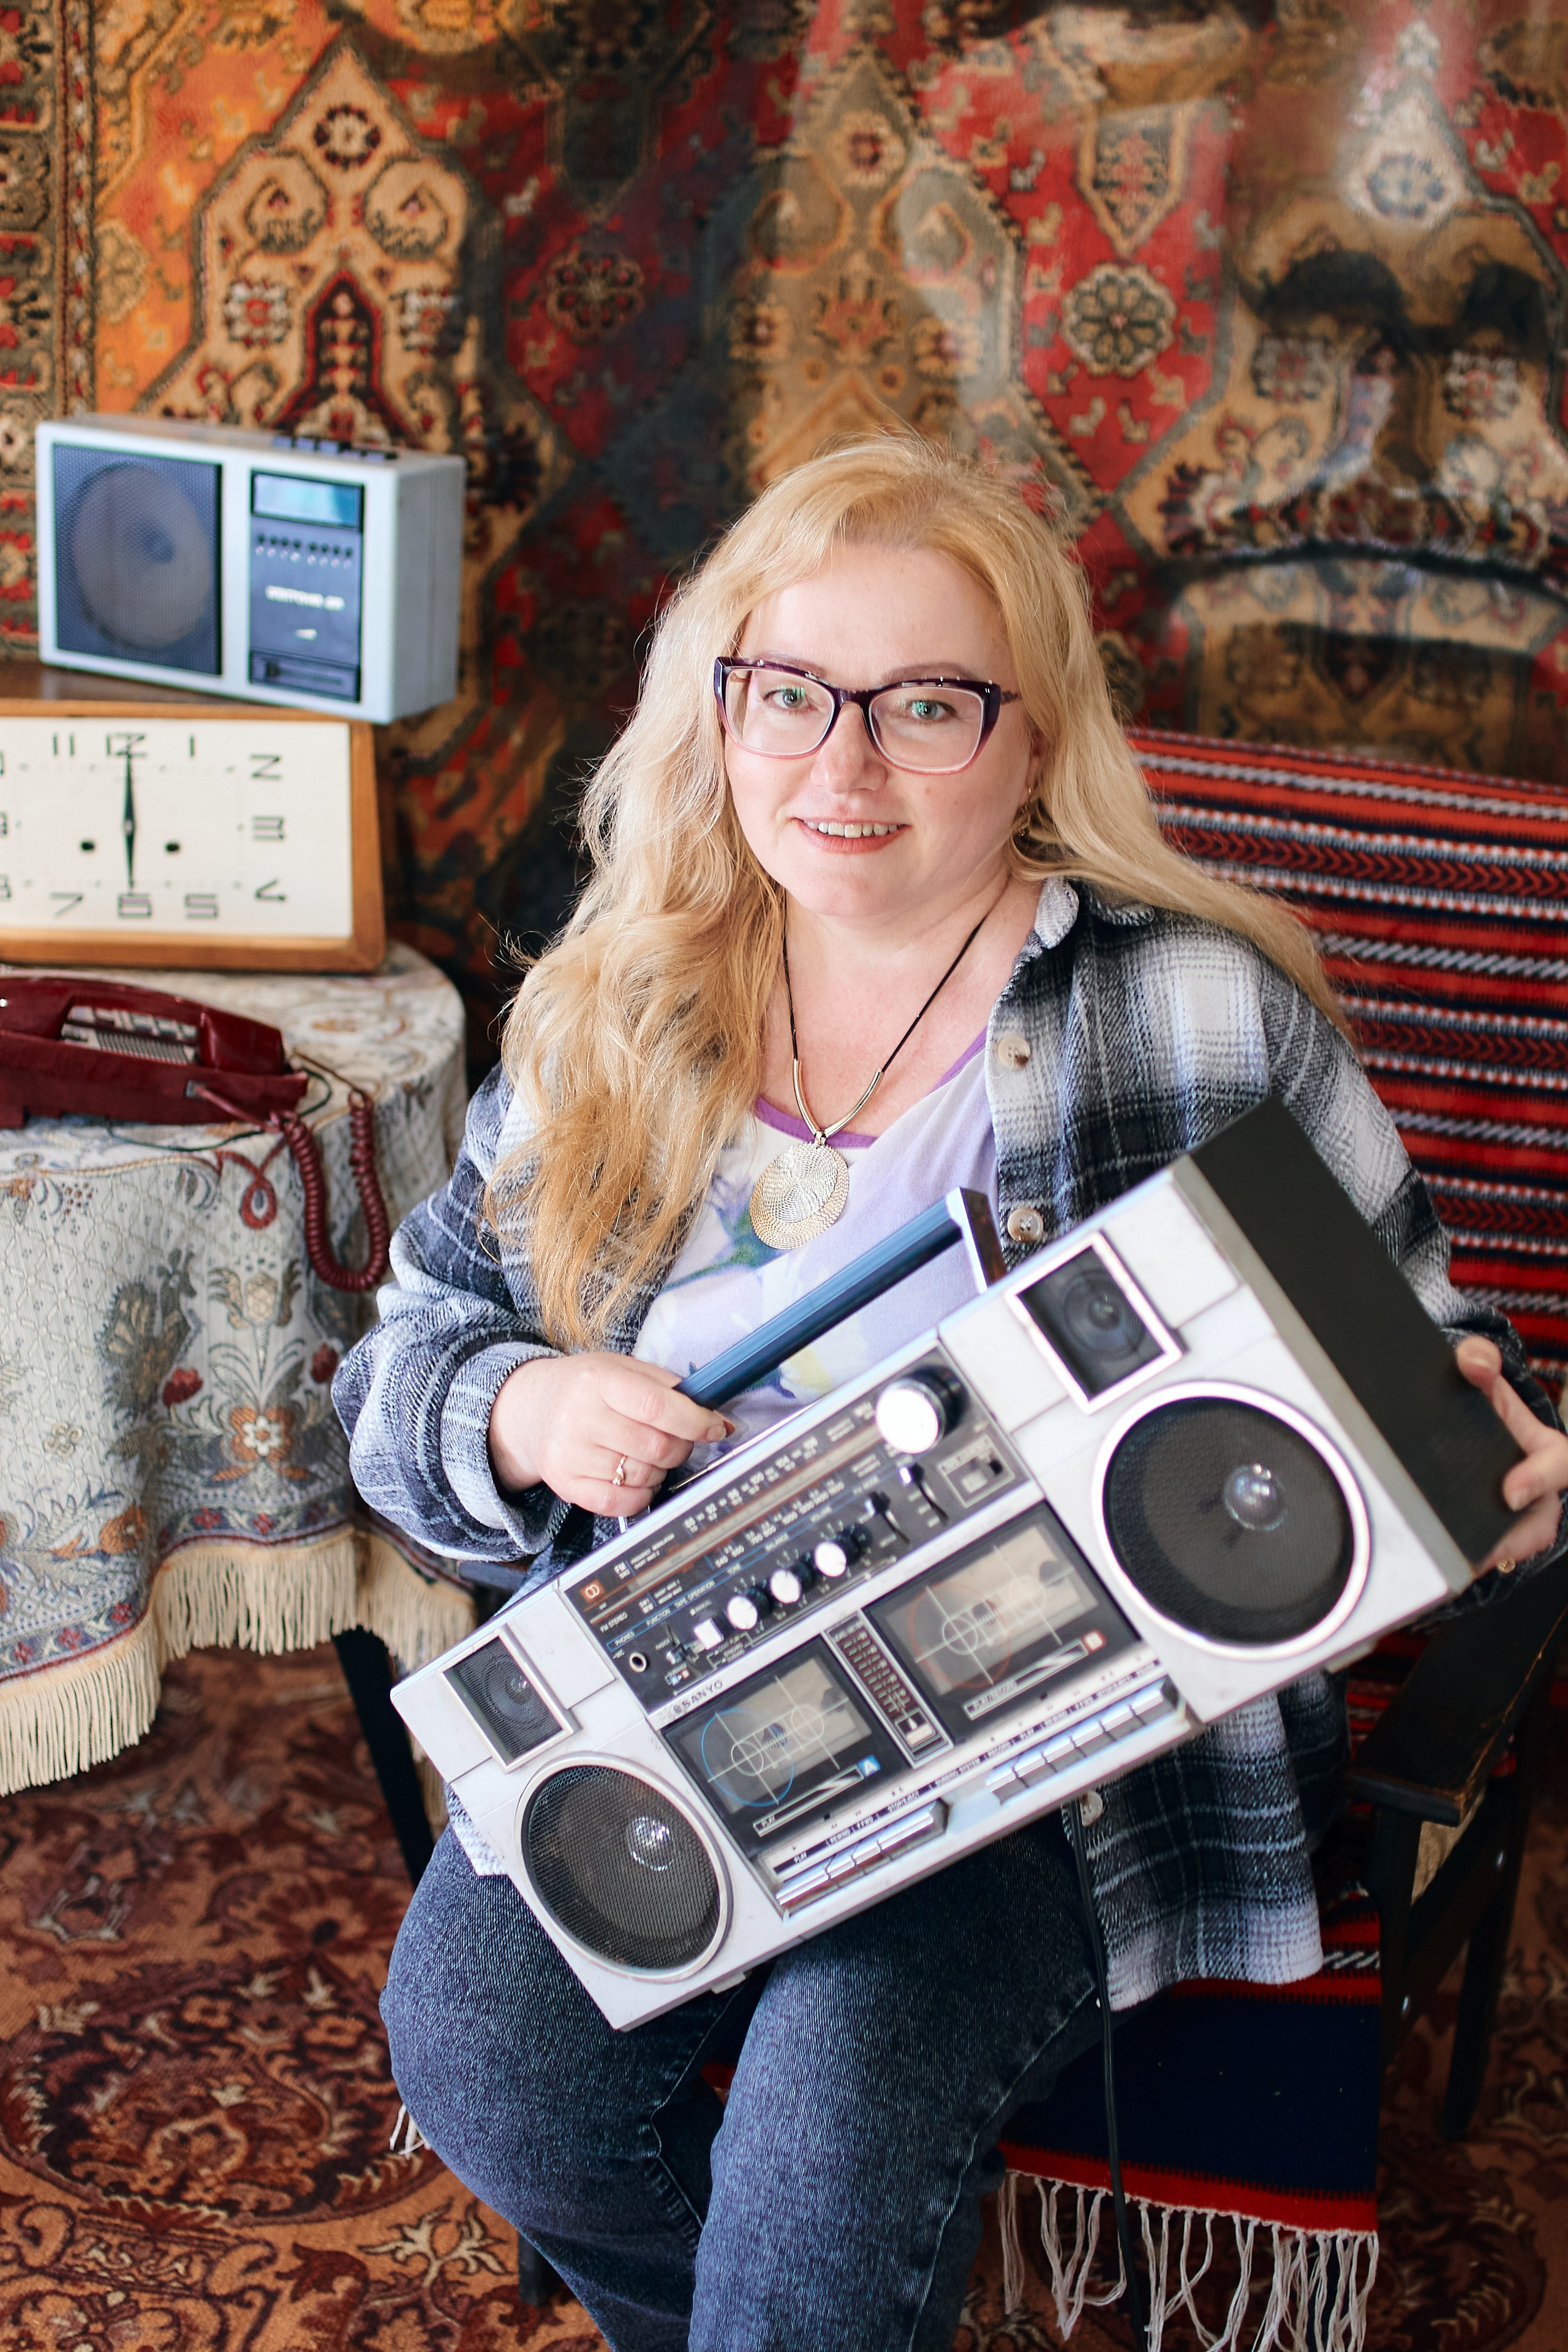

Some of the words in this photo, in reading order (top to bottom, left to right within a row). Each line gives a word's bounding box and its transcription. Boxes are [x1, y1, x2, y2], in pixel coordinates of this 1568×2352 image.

[52, 734, 75, 756] 11
[105, 733, 147, 757] 12
[189, 734, 195, 758] 1
[251, 754, 282, 780] 2
[252, 816, 285, 841] 3
[50, 892, 83, 918] 7
[118, 894, 152, 919] 6
[185, 894, 218, 919] 5
[684, 1517, 695, 1528] 88
[704, 1503, 717, 1514] 92
[750, 1472, 764, 1484] 100
[750, 1534, 763, 1545] 700
[765, 1534, 788, 1550] BALANCE
[614, 1562, 626, 1573] FM
[727, 1563, 742, 1575] TONE
[674, 1597, 687, 1608] TAPE
[687, 1580, 714, 1599] OPERATION
[608, 1612, 627, 1626] STEREO
[646, 1609, 670, 1625] FUNCTION
[615, 1631, 634, 1645] PHONES
[682, 1681, 722, 1708] SANYO
[988, 1741, 1010, 1757] RECORD
[861, 1759, 876, 1775] A
[960, 1757, 979, 1772] SYSTEM
[888, 1791, 918, 1812] STOP/EJECT
[830, 1828, 850, 1843] REWIND
[793, 1852, 807, 1863] PLAY
